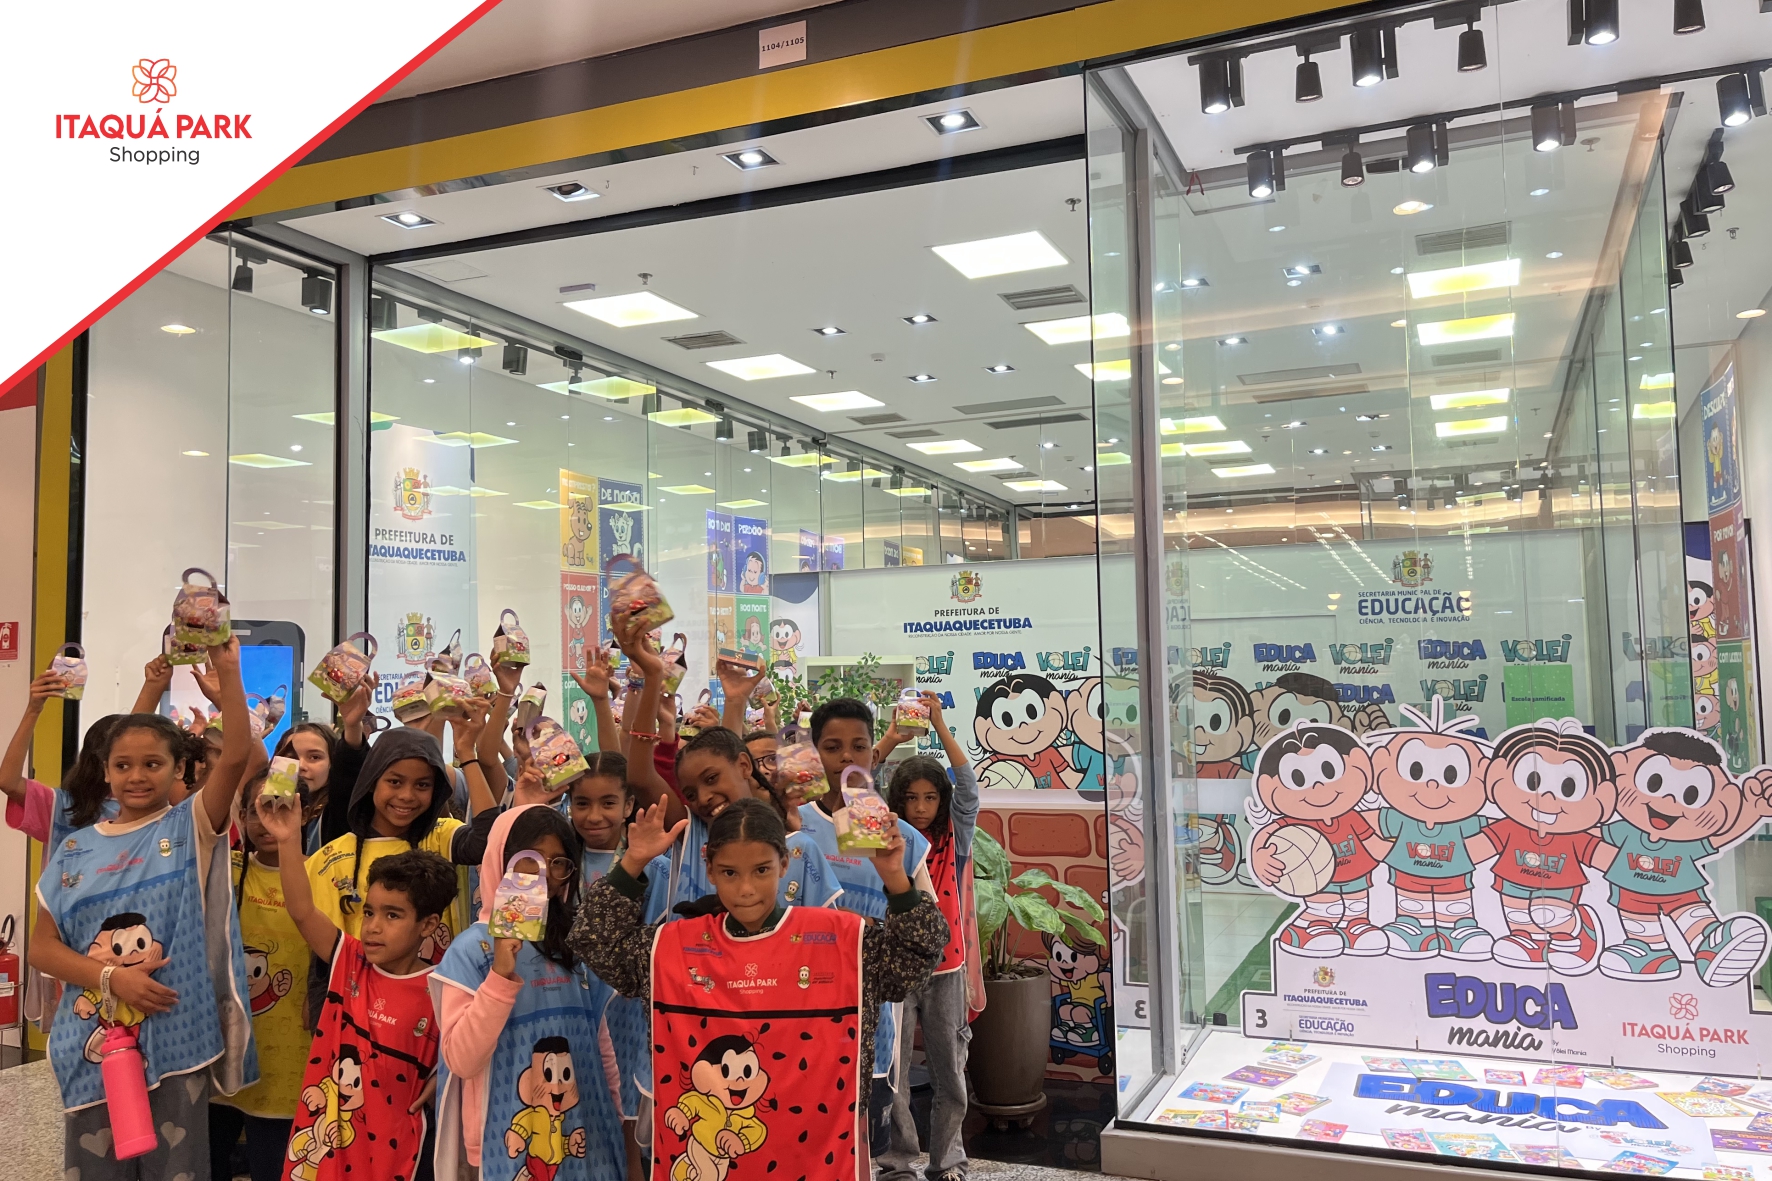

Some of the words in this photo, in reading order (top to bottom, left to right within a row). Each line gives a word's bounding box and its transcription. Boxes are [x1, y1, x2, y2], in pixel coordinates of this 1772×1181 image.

[762, 37, 804, 52] 1104/1105
[375, 528, 437, 545] PREFEITURA
[440, 534, 454, 545] DE
[369, 544, 467, 562] TAQUAQUECETUBA
[1358, 590, 1395, 598] SECRETARIA
[1397, 589, 1431, 597] MUNICPAL
[934, 607, 985, 617] PREFEITURA
[988, 607, 1000, 615] DE
[904, 618, 1032, 633] ITAQUAQUECETUBA
[1253, 643, 1317, 663] EDUCA
[1418, 639, 1487, 661] EDUCA
[973, 651, 1026, 670] EDUCA
[1263, 662, 1300, 672] mania
[1428, 659, 1469, 670] mania
[980, 668, 1012, 679] mania
[1046, 671, 1078, 680] mania
[1340, 664, 1378, 675] mania
[379, 673, 403, 681] ECRETARIA
[1413, 859, 1443, 869] mania
[1520, 867, 1552, 880] mania
[1633, 871, 1667, 884] mania
[273, 899, 286, 909] PAR
[756, 978, 778, 987] PARK
[1304, 988, 1338, 996] PREFEITURA
[1283, 994, 1368, 1007] ITAQUAQUECETUBA
[1424, 972, 1578, 1031] EDUCA
[379, 1013, 397, 1026] PARK
[1255, 1008, 1268, 1029] 3
[1298, 1019, 1355, 1033] EDUCAÇÃO
[1447, 1025, 1543, 1051] mania
[1622, 1022, 1695, 1042] ITAQUÁ
[1699, 1027, 1750, 1045] PARK
[1657, 1043, 1716, 1058] Shopping
[1354, 1073, 1669, 1130] EDUCA
[1384, 1103, 1582, 1134] mania
